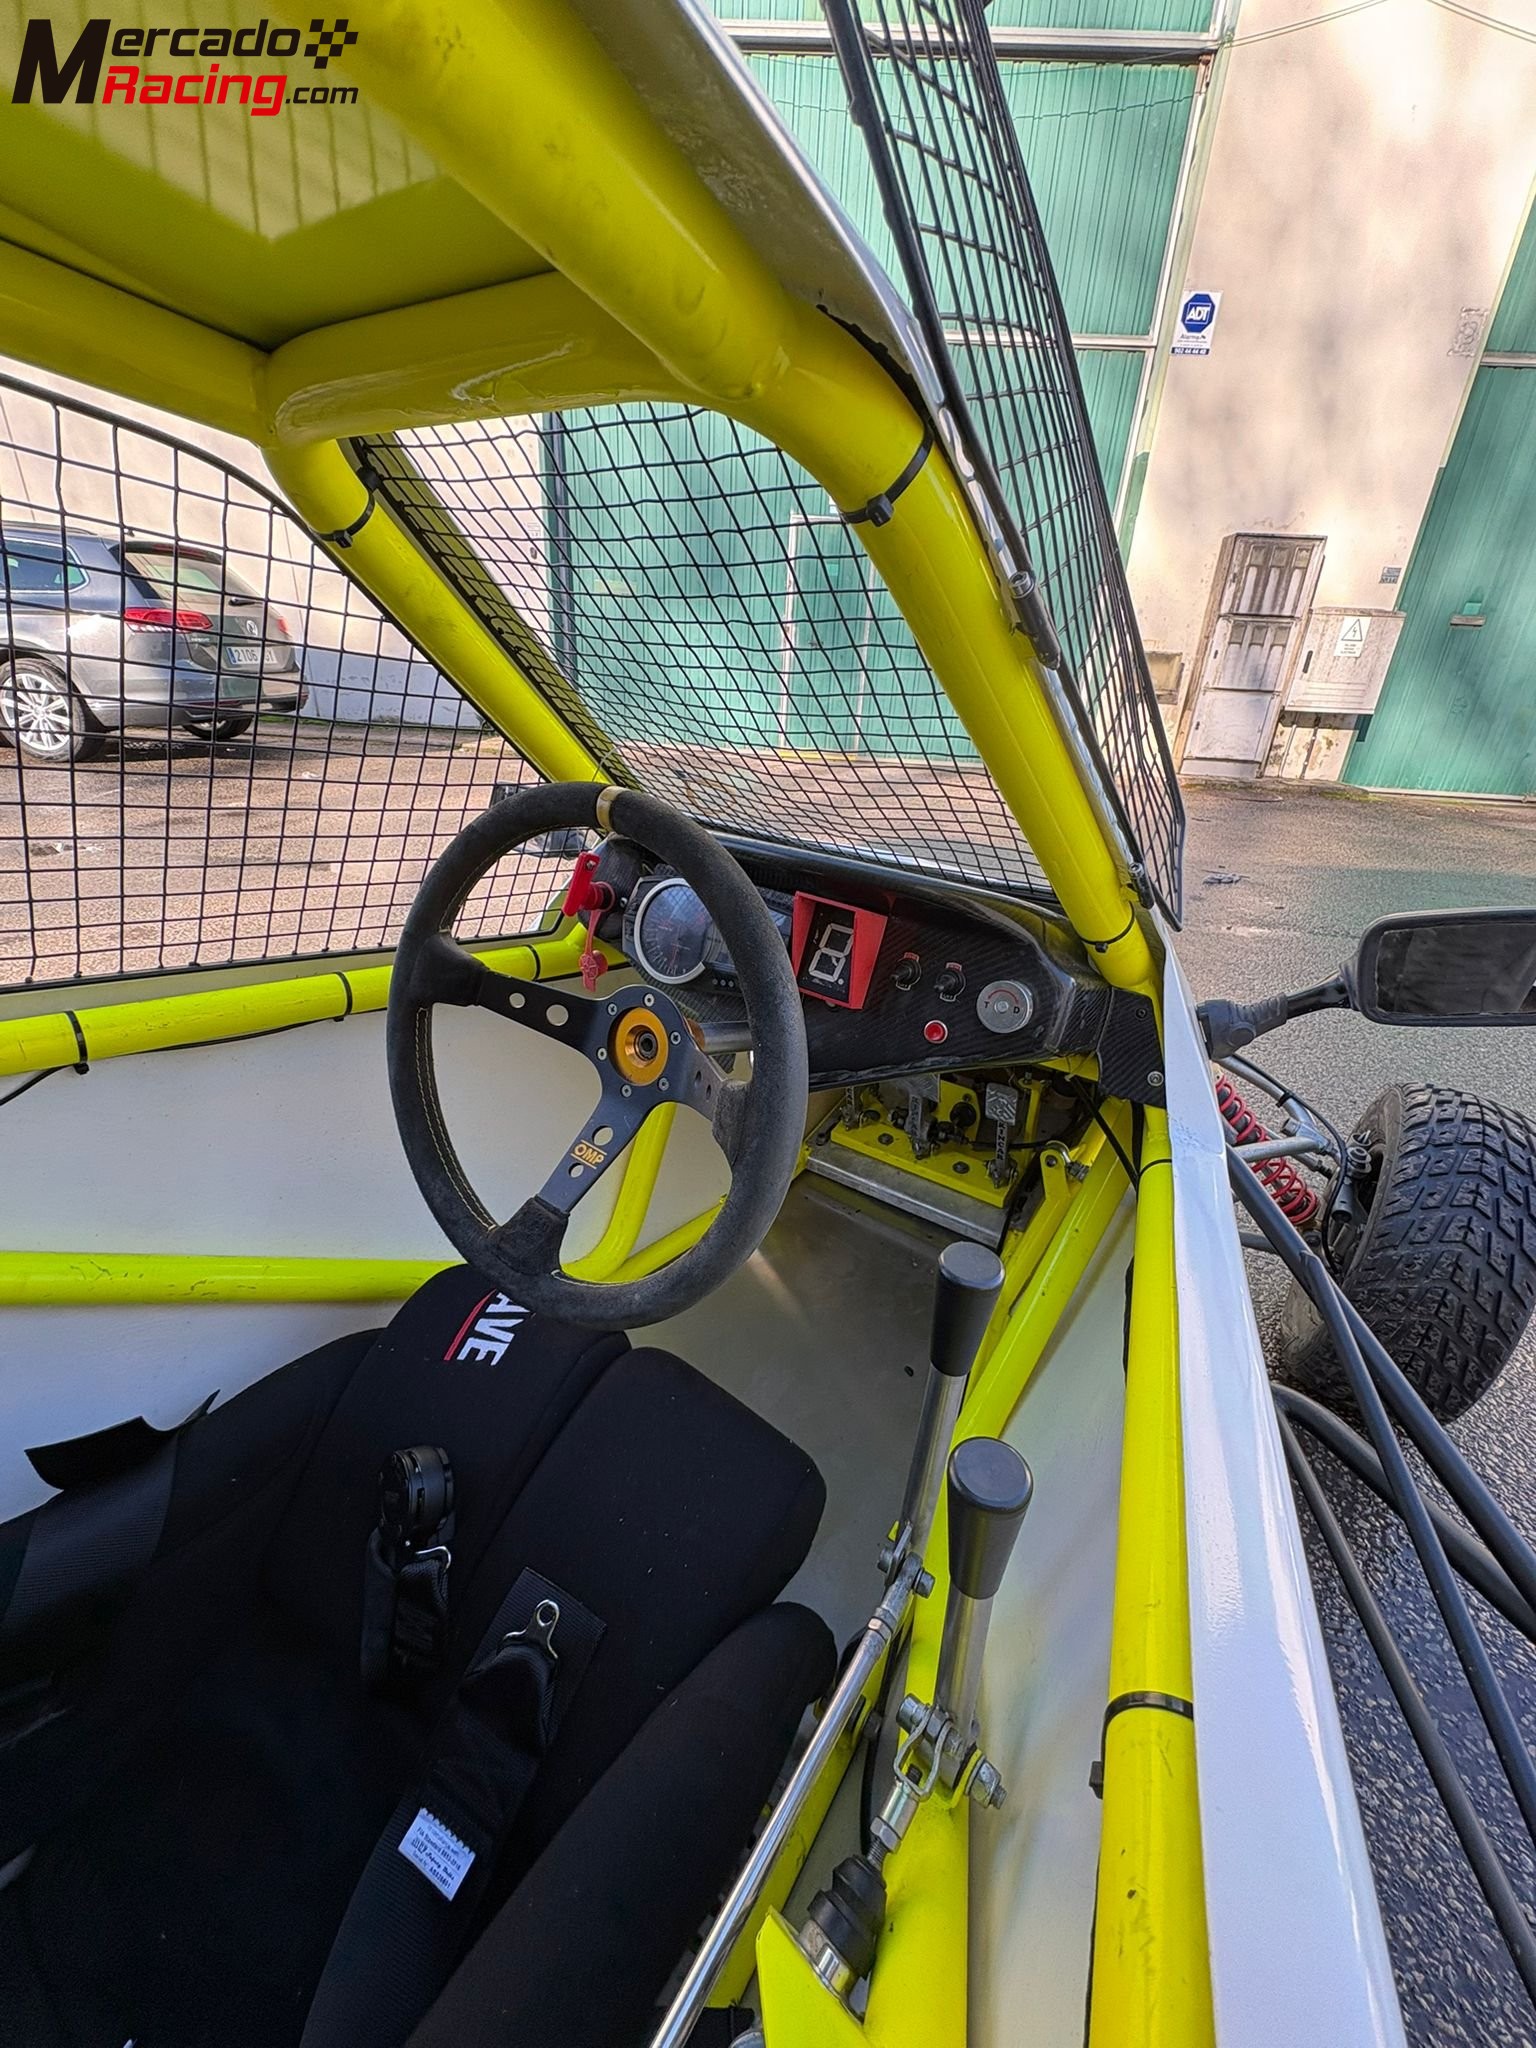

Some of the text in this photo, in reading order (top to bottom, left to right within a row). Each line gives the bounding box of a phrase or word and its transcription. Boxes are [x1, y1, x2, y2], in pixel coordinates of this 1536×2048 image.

[1186, 306, 1210, 321] ADT
[234, 649, 258, 662] 2106
[574, 1143, 605, 1165] OMP
